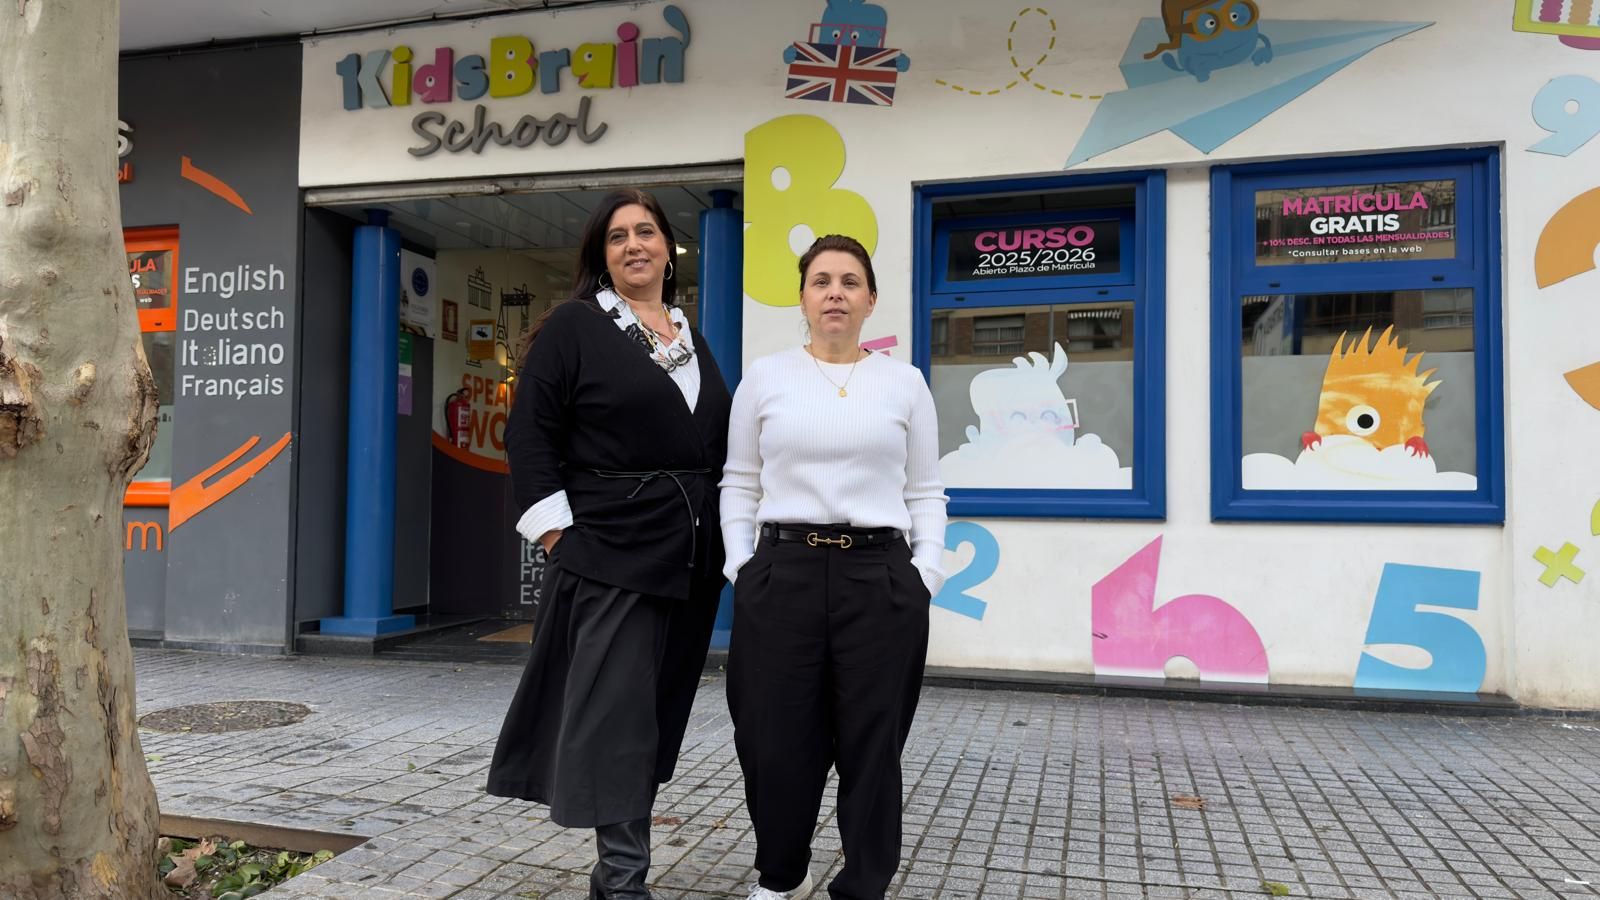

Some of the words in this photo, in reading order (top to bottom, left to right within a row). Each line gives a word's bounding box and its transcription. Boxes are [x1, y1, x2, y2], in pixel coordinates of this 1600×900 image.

[408, 96, 608, 157] School
[1282, 190, 1428, 216] MATRÍCULA
[1310, 213, 1400, 235] GRATIS
[974, 225, 1095, 252] CURSO
[1287, 237, 1311, 246] DESC.
[1312, 236, 1326, 245] EN
[1327, 235, 1356, 244] TODAS
[1357, 234, 1374, 243] LAS
[1375, 231, 1450, 243] MENSUALIDADES
[1342, 246, 1370, 256] bases
[1400, 245, 1422, 254] web
[972, 266, 1007, 276] Abierto
[1009, 265, 1035, 274] Plazo
[1037, 263, 1050, 272] de
[1052, 261, 1096, 271] Matrícula
[978, 247, 1096, 267] 2025/2026
[184, 264, 285, 298] English
[183, 306, 284, 332] Deutsch
[182, 373, 284, 400] Français
